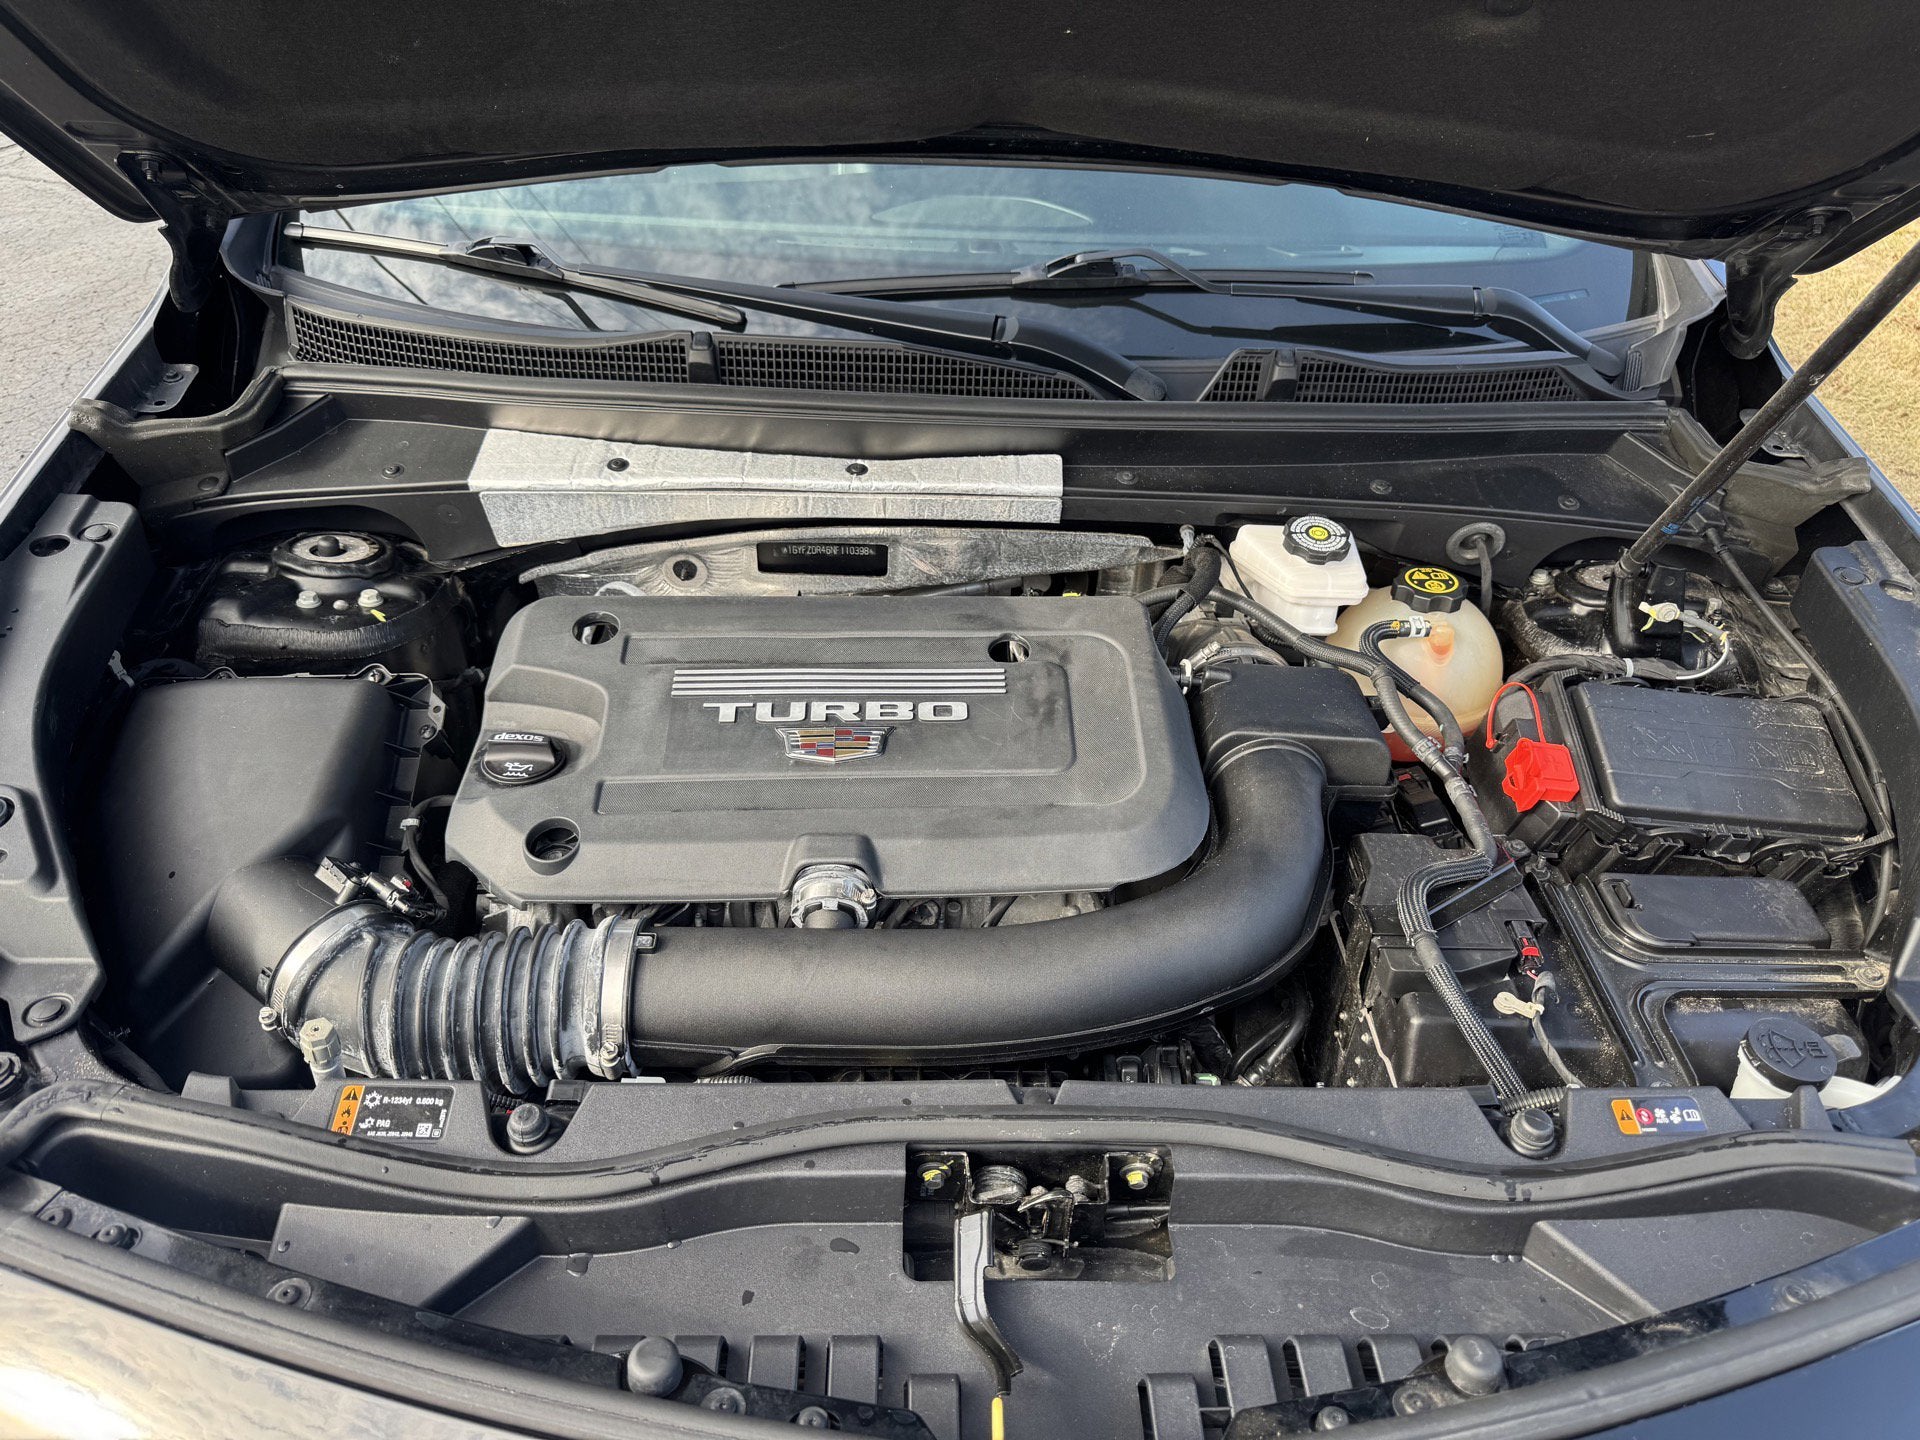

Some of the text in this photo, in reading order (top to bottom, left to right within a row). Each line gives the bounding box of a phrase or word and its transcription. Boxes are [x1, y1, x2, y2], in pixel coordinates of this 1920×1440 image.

[703, 701, 969, 723] TURBO
[494, 732, 545, 742] dexos
[382, 1096, 413, 1105] R-1234yf
[435, 1097, 444, 1106] kg
[376, 1119, 391, 1127] PAG
